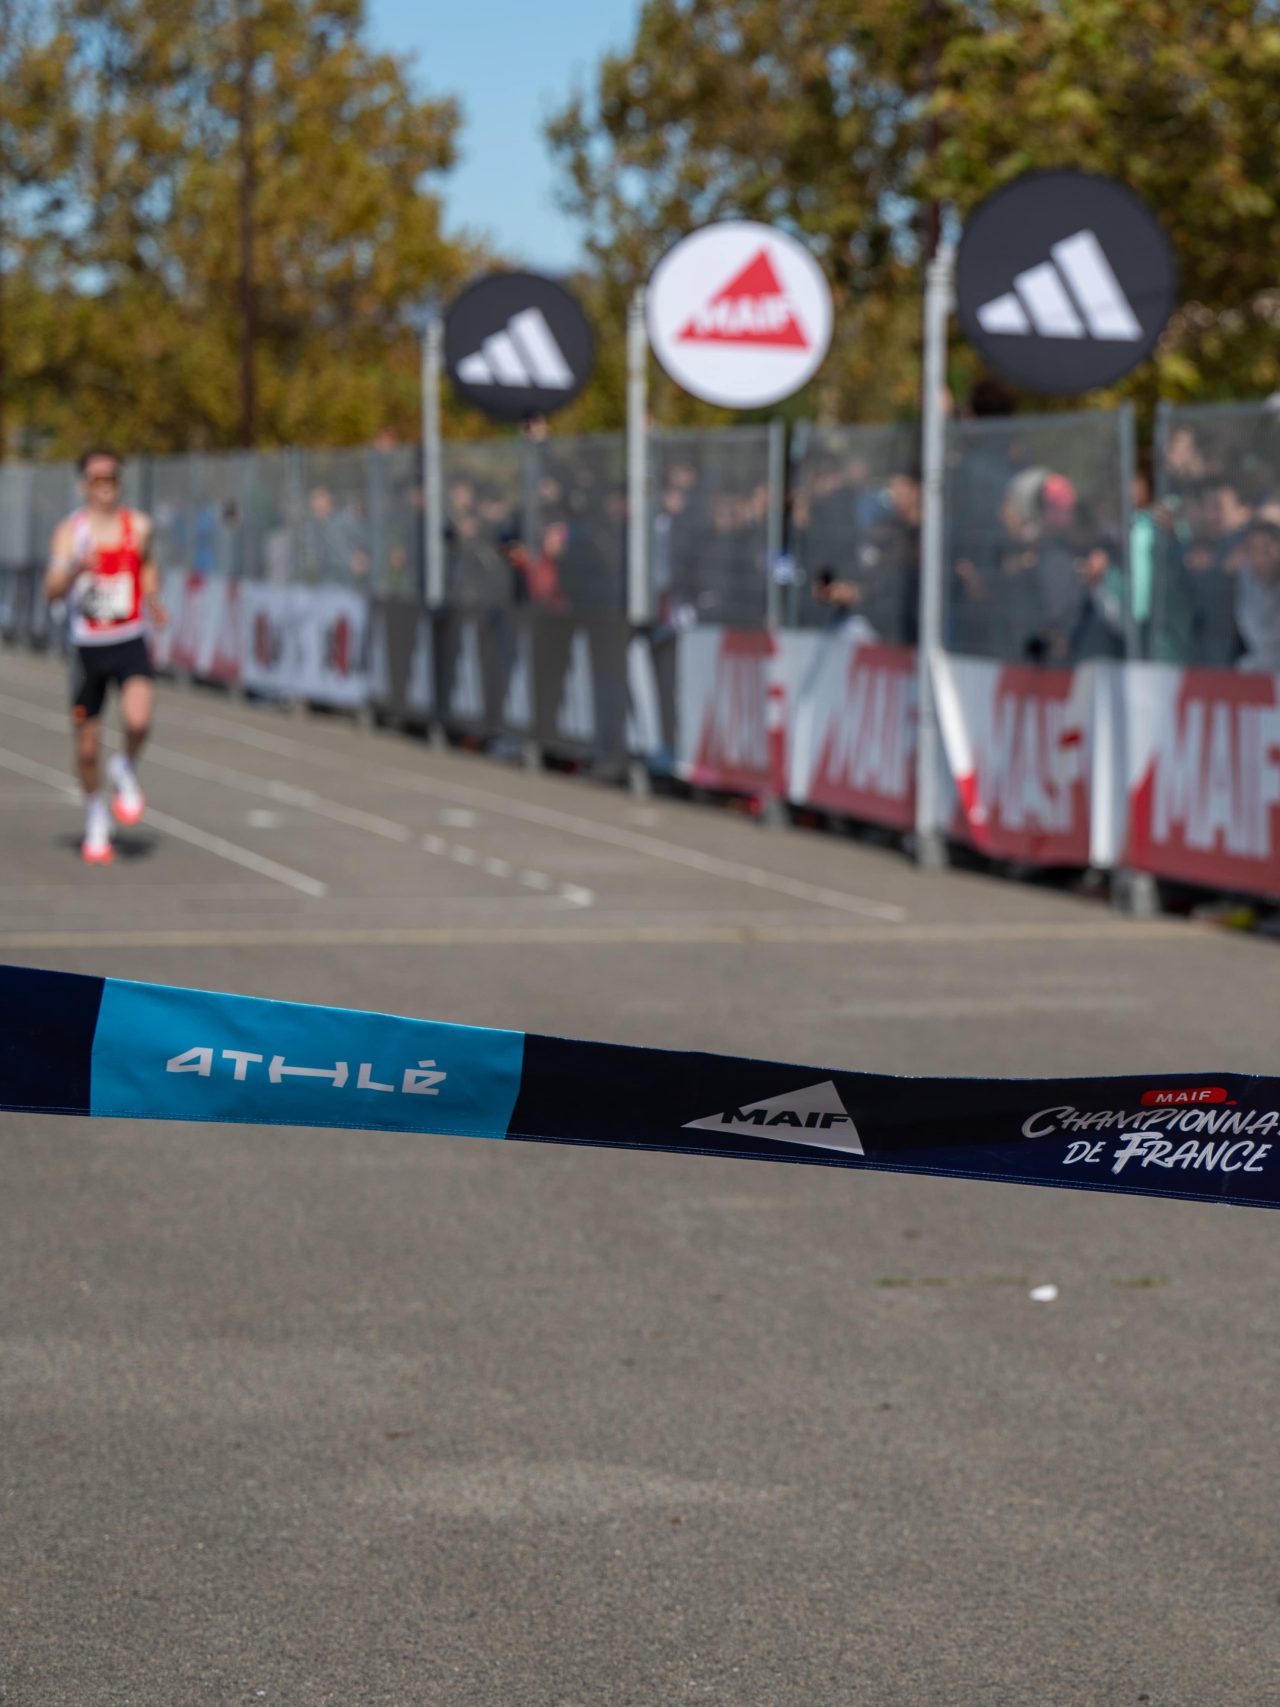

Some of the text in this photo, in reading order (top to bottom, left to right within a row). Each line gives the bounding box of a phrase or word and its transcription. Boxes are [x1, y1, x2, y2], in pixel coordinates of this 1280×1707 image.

[694, 294, 790, 337] MAIF
[165, 1046, 448, 1096] ATHLÉ
[720, 1107, 850, 1129] MAIF
[1154, 1090, 1213, 1104] MAIF
[1061, 1131, 1273, 1176] DE FRANCE
